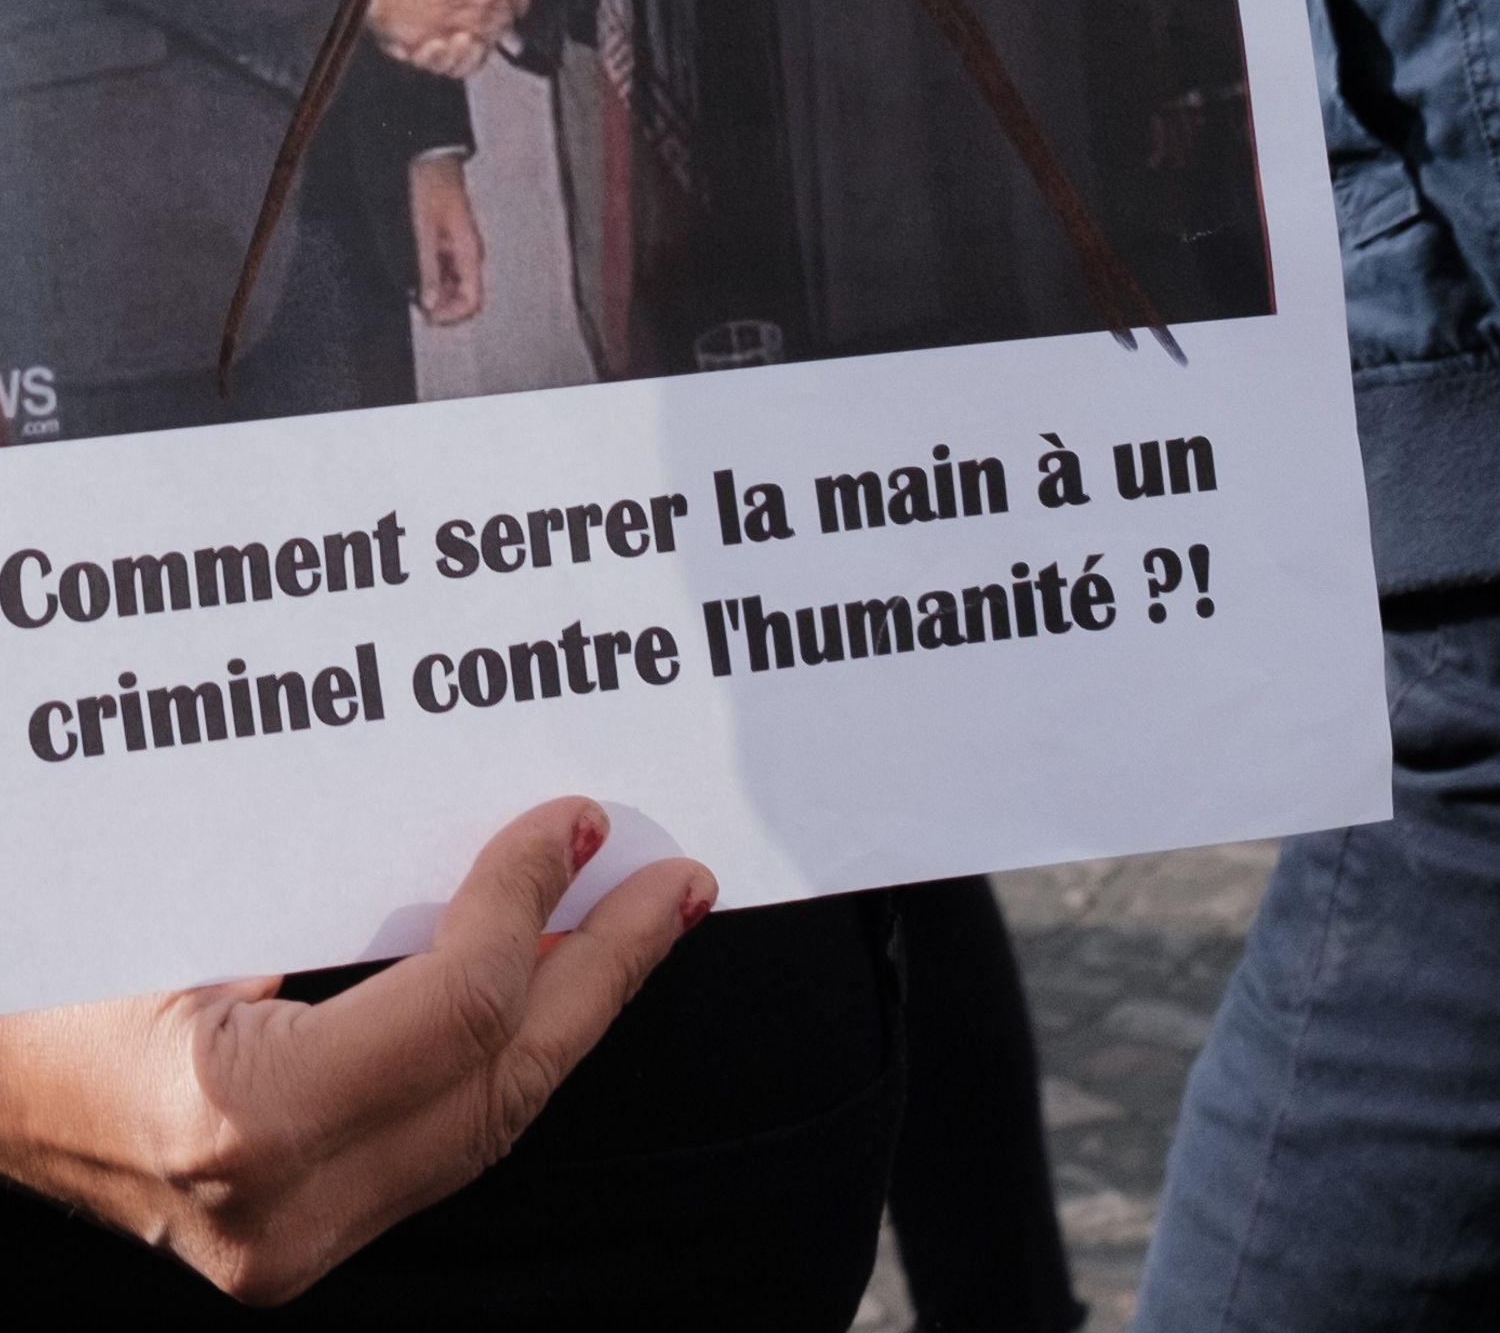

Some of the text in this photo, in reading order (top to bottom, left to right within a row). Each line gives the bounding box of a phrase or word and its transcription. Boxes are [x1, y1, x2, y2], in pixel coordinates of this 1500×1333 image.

[434, 492, 689, 580] serrer
[712, 467, 797, 547] la
[813, 442, 1011, 535] main
[1036, 431, 1093, 510] à
[1111, 434, 1219, 502] un
[27, 542, 1217, 764] criminel contre l'humanité ?!
